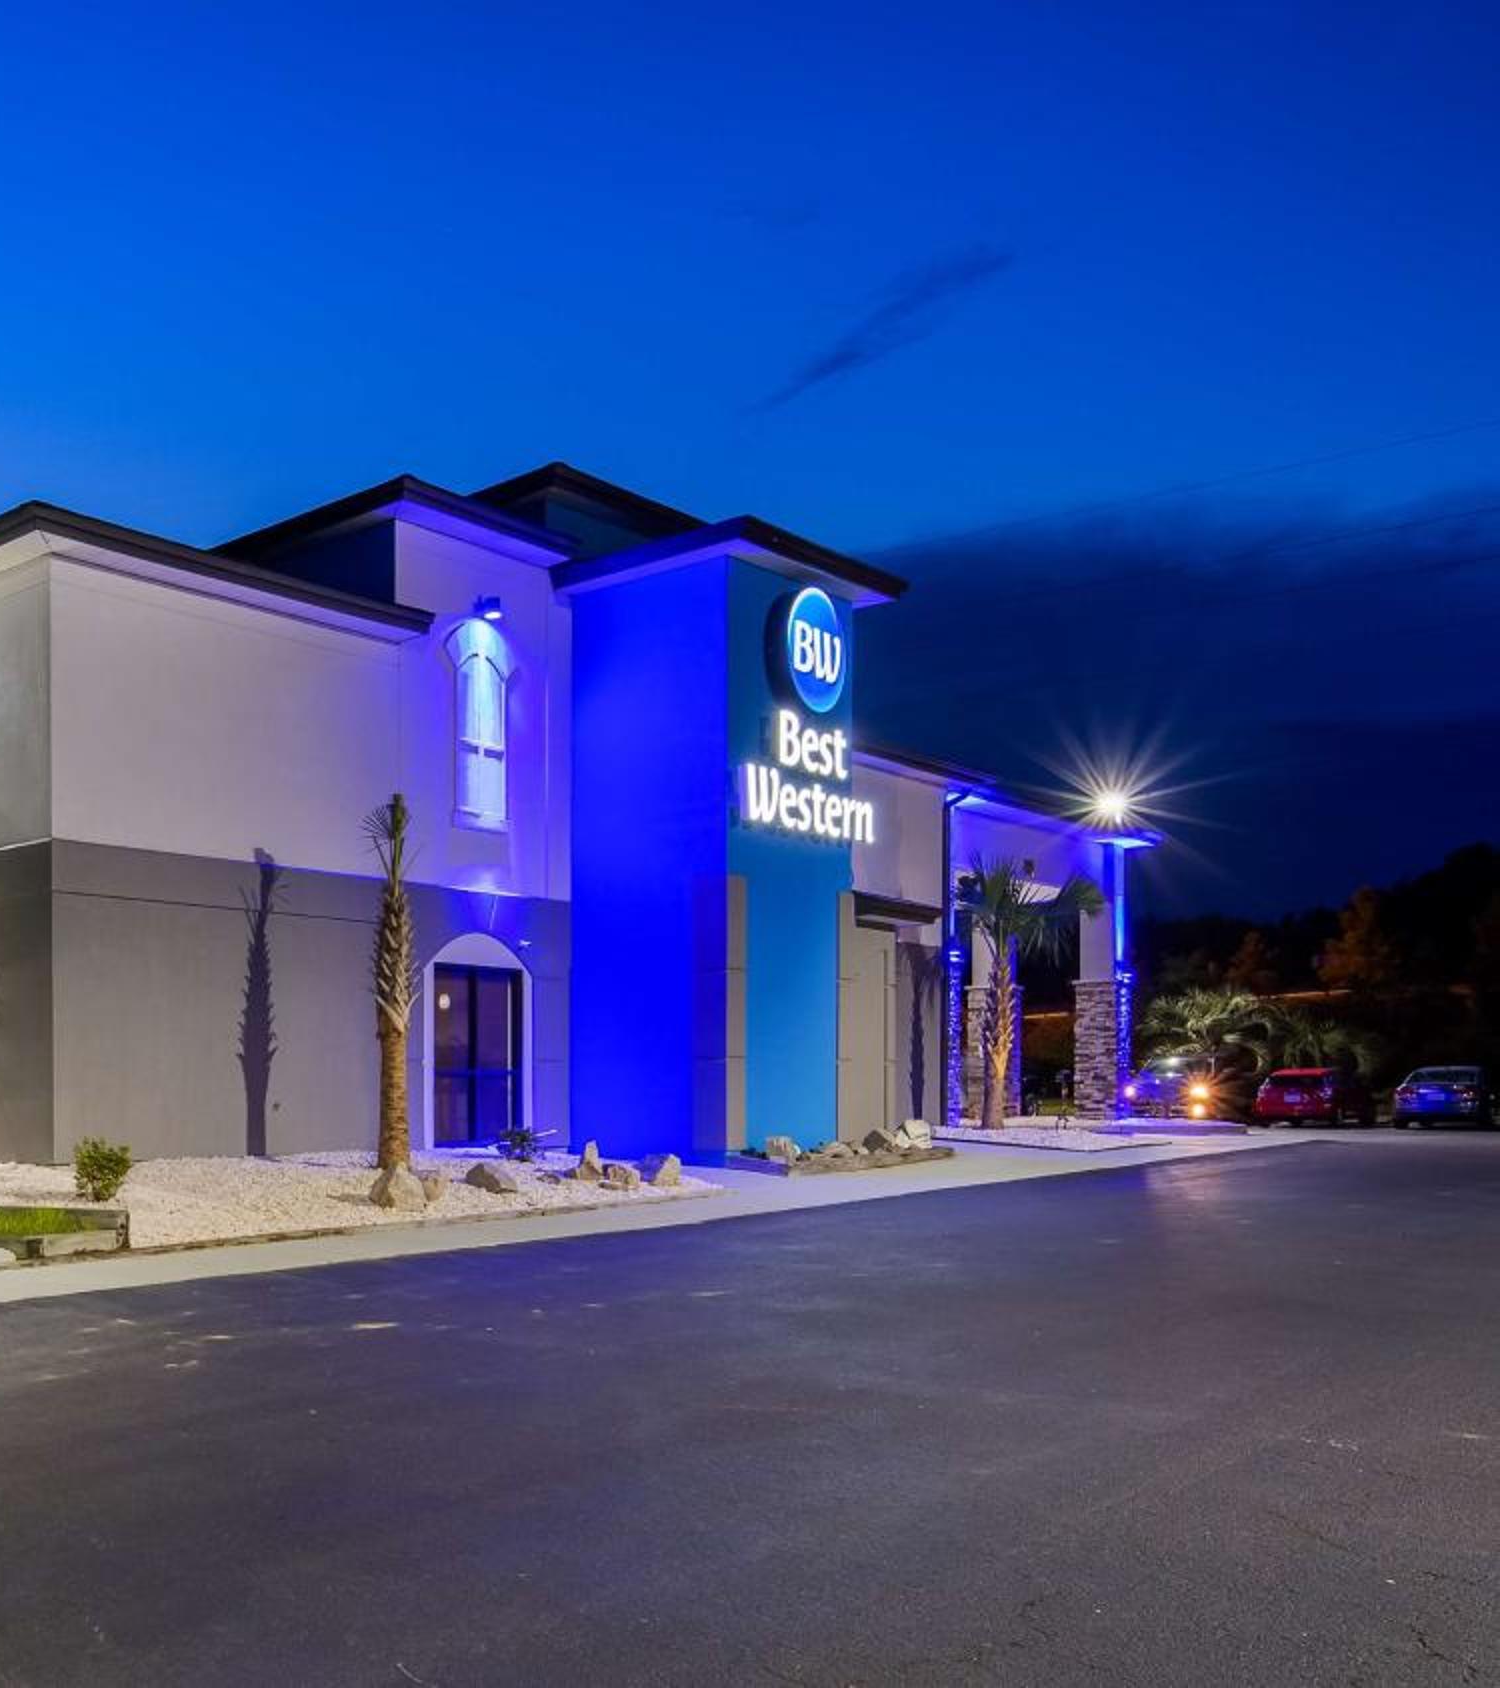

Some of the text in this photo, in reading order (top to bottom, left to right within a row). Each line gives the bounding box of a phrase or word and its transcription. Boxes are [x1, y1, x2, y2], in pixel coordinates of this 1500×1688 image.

[793, 620, 841, 683] BW
[778, 710, 848, 780] Best
[746, 764, 875, 843] Western
